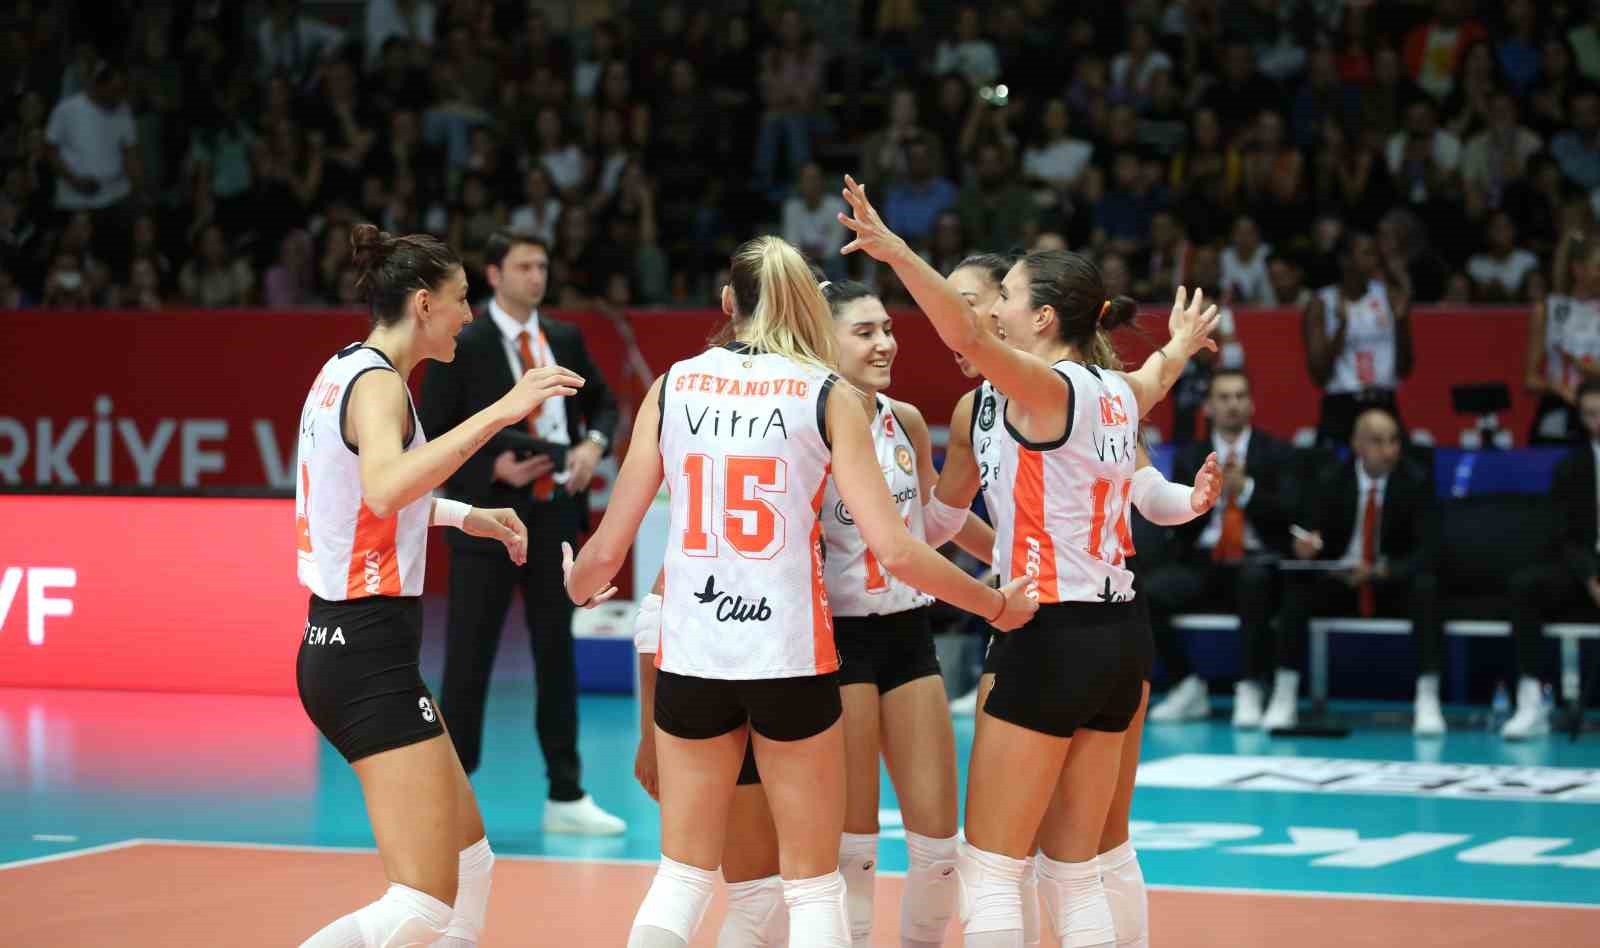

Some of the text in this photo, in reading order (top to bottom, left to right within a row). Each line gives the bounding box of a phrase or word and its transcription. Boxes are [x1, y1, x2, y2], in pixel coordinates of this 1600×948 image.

[674, 372, 810, 400] STEVANOVIC
[682, 453, 788, 560] 15
[716, 594, 773, 623] Club
[418, 696, 437, 723] 3
